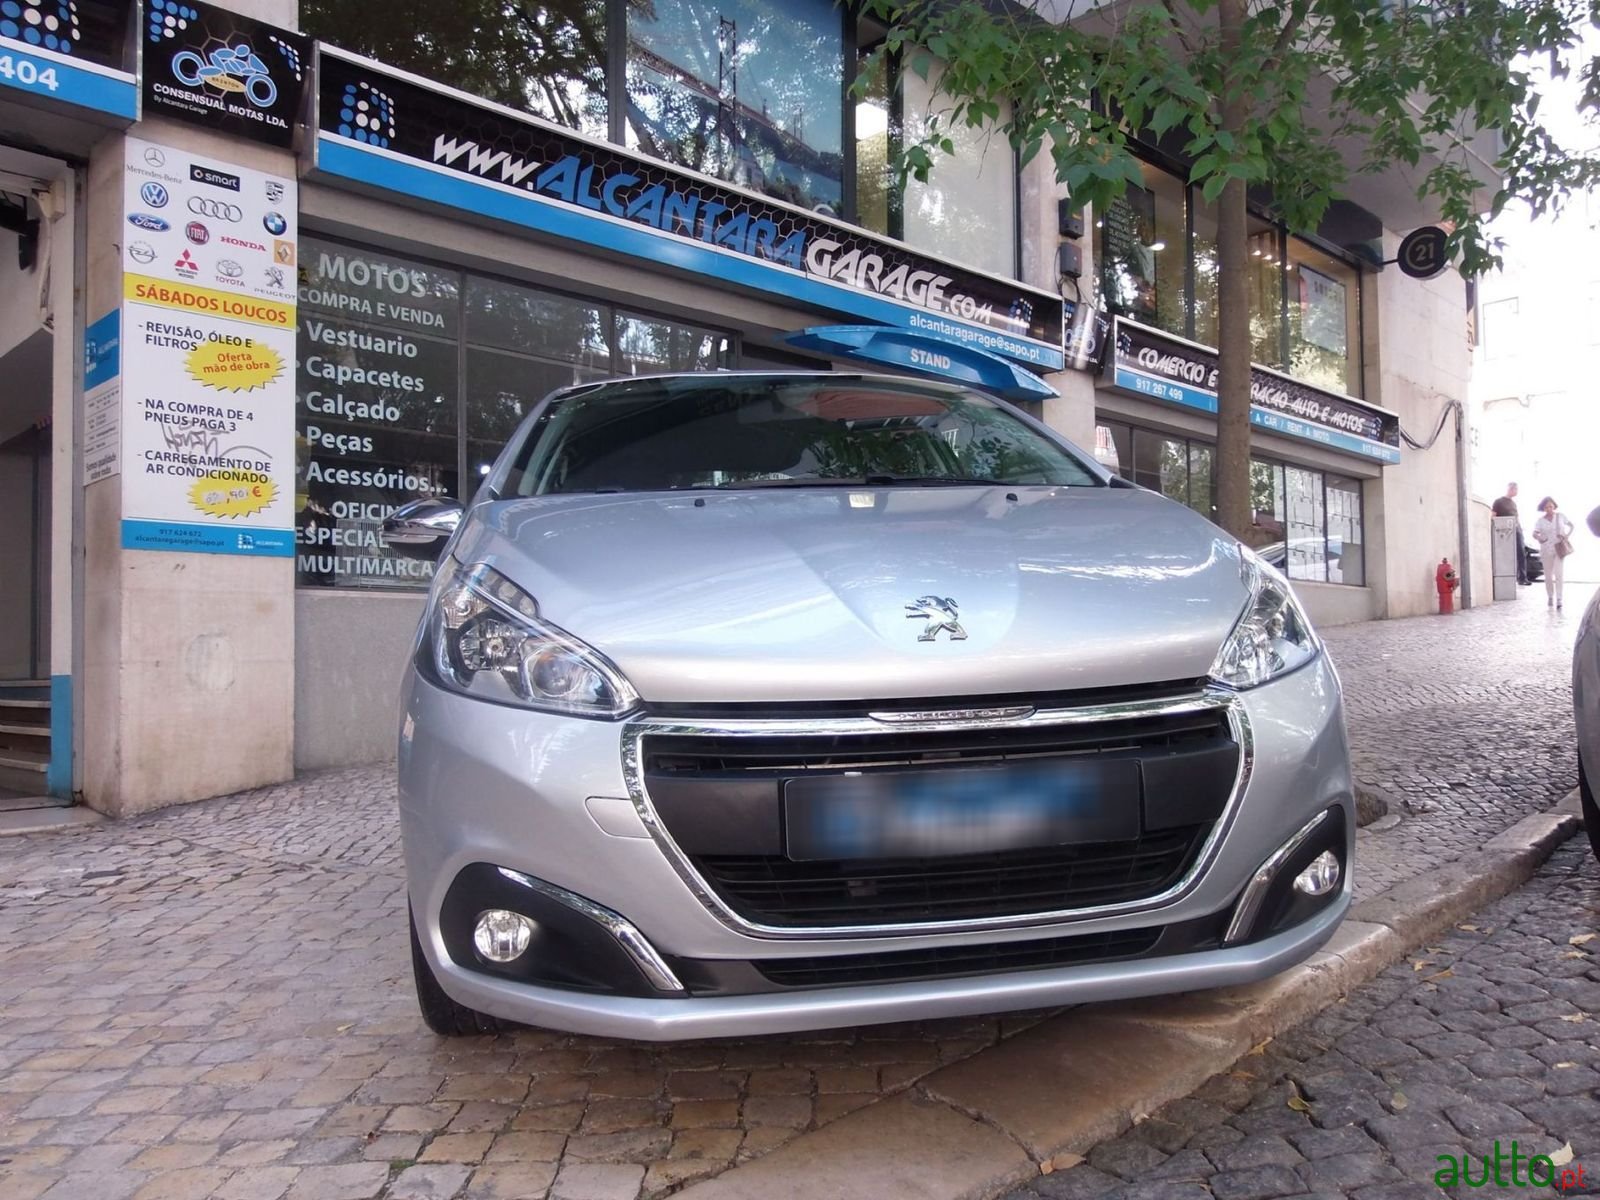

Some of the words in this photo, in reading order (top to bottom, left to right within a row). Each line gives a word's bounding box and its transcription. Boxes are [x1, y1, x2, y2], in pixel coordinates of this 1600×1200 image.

[153, 83, 226, 111] CONSENSUAL
[228, 103, 264, 122] MOTAS
[266, 114, 289, 129] LDA.
[126, 164, 183, 185] Mercedes-Benz
[204, 172, 238, 188] smart
[135, 216, 163, 231] Ford
[190, 227, 206, 241] FIAT
[220, 236, 267, 252] HONDA
[1415, 242, 1434, 262] 21
[215, 275, 246, 288] TOYOTA
[319, 253, 427, 298] MOTOS
[136, 284, 219, 311] SÁBADOS
[223, 300, 288, 324] LOUCOS
[254, 287, 297, 300] PEUGEOT
[297, 287, 372, 314] COMPRA
[376, 302, 386, 317] E
[389, 305, 445, 328] VENDA
[145, 334, 198, 352] FILTROS
[208, 331, 242, 347] ÓLEO
[244, 338, 253, 349] E
[305, 320, 418, 358] Vestuario
[909, 314, 1040, 361] alcantaragarage@sapo.pt
[203, 364, 228, 374] mão
[229, 362, 243, 372] de
[245, 360, 271, 371] obra
[217, 352, 252, 364] Oferta
[910, 349, 951, 370] STAND
[1137, 347, 1205, 383] COMERCIO
[305, 356, 425, 392] Capacetes
[1136, 378, 1151, 390] 917
[145, 399, 165, 411] NA
[168, 401, 224, 418] COMPRA
[227, 409, 244, 420] DE
[245, 412, 254, 422] 4
[305, 391, 400, 422] Calçado
[145, 411, 188, 426] PNEUS
[191, 418, 226, 432] PAGA
[229, 421, 237, 432] 3
[1331, 411, 1366, 433] MOTOS
[306, 425, 374, 456] Peças
[144, 450, 252, 472] CARREGAMENTO
[254, 461, 272, 473] DE
[145, 463, 164, 474] AR
[167, 465, 269, 484] CONDICIONADO
[305, 461, 448, 493] Acessórios...
